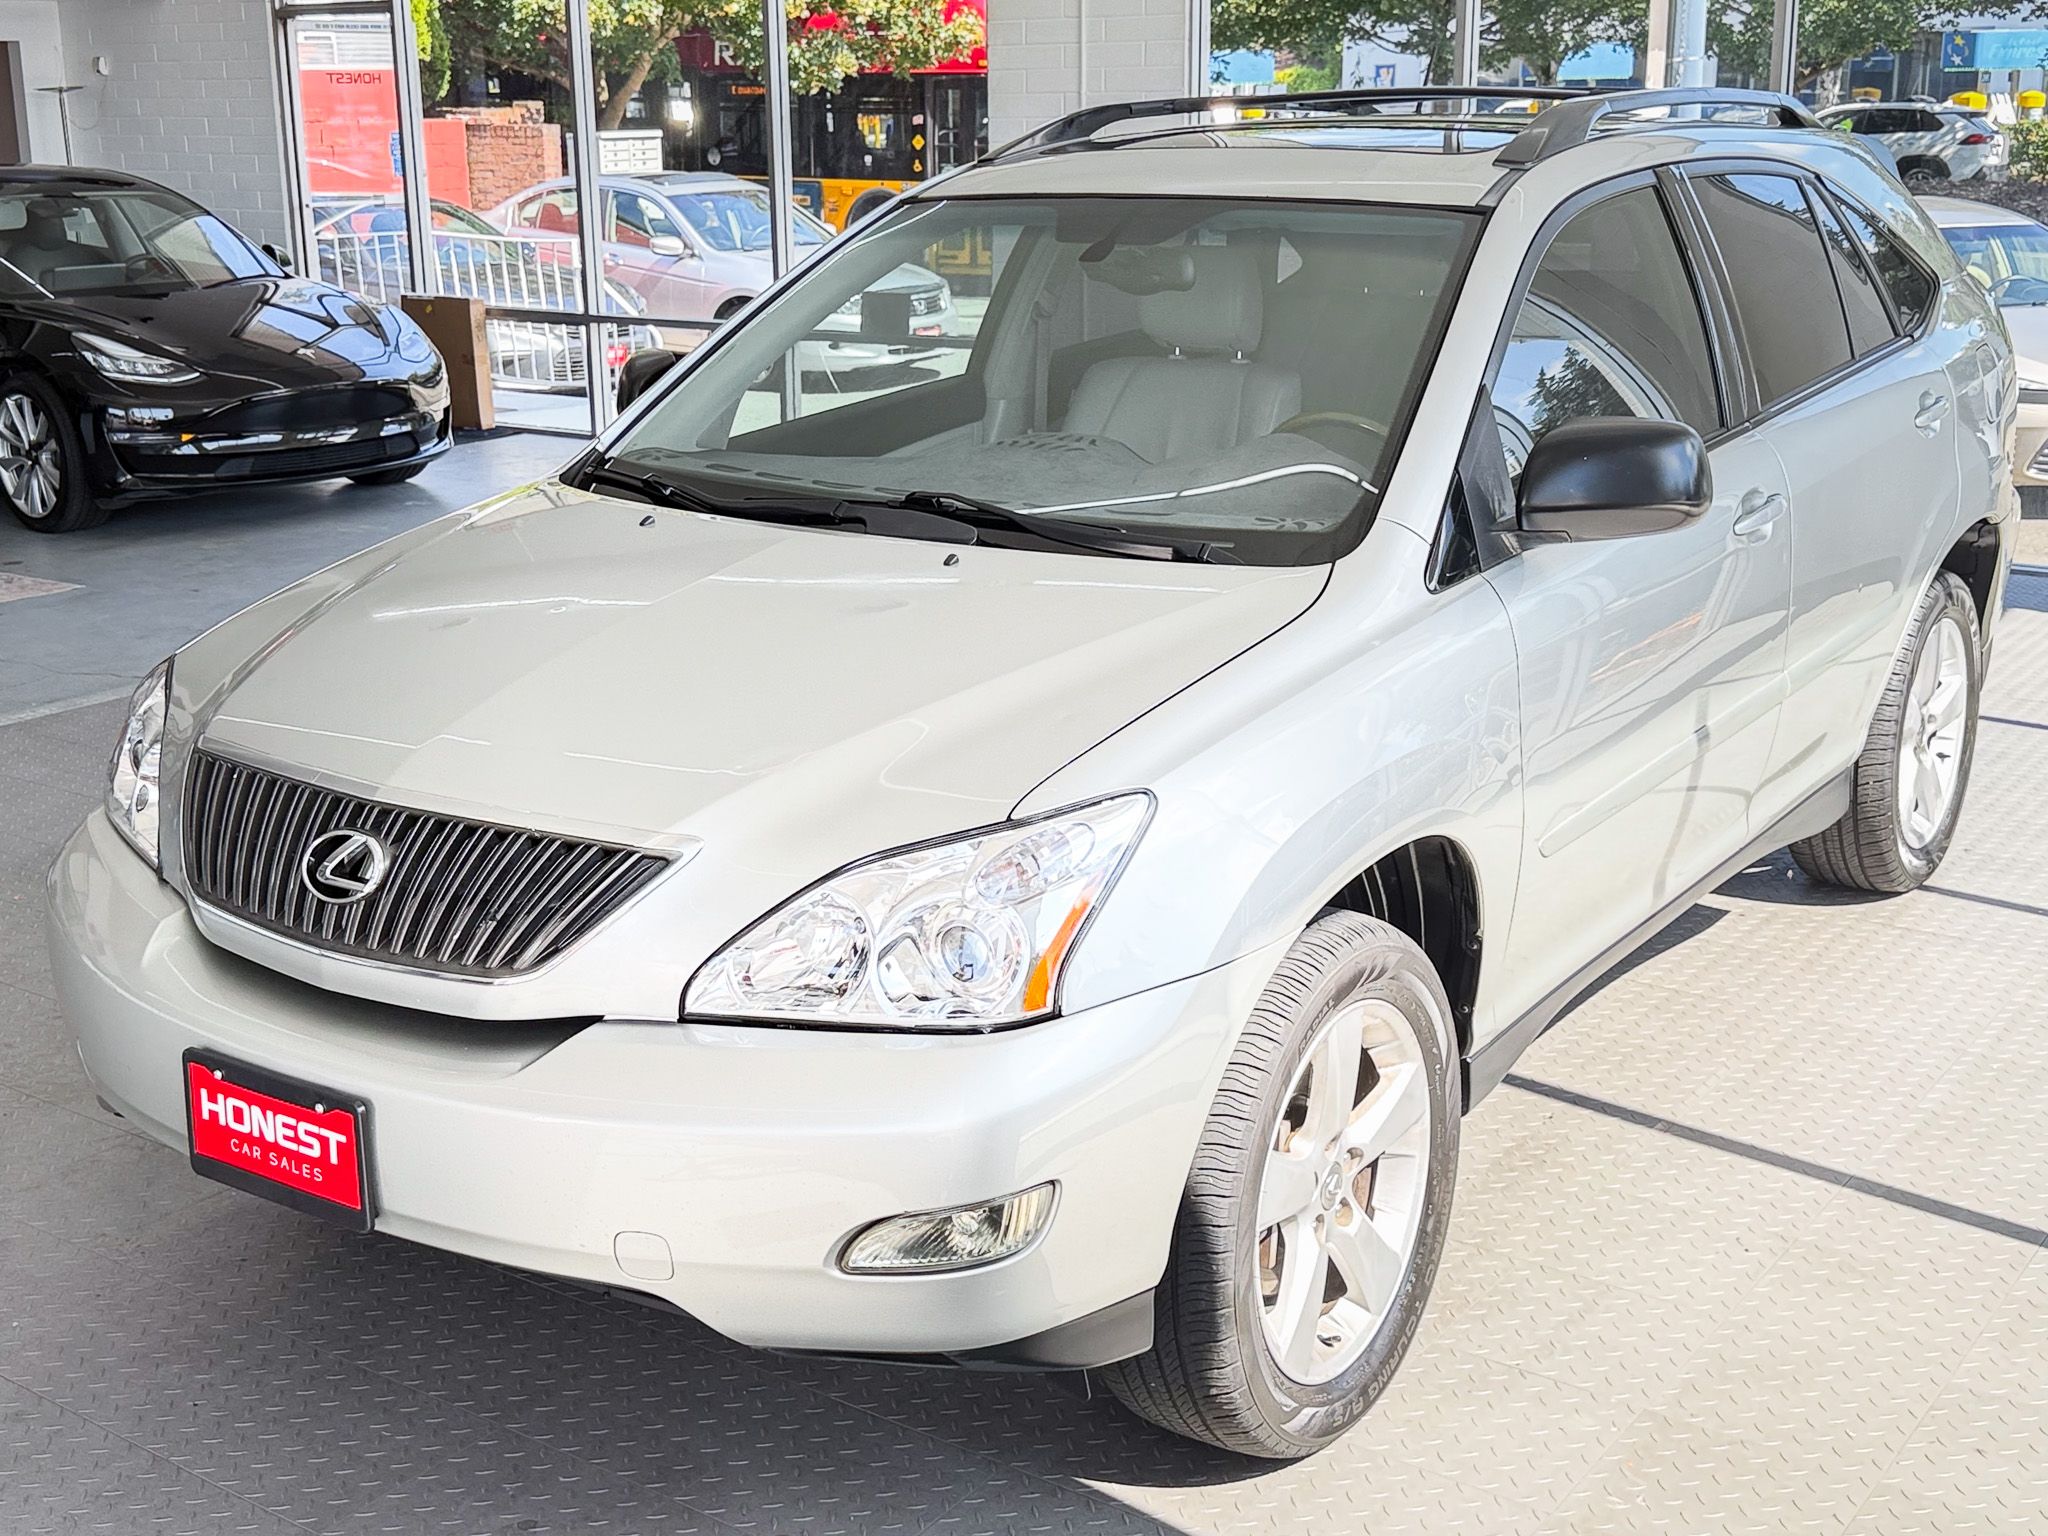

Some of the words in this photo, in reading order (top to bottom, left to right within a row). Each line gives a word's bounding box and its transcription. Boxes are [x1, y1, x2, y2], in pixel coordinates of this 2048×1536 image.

[200, 1087, 347, 1165] HONEST
[230, 1138, 261, 1160] CAR
[269, 1151, 323, 1182] SALES
[1368, 1300, 1424, 1401] TOURING
[1331, 1396, 1364, 1428] A/S
